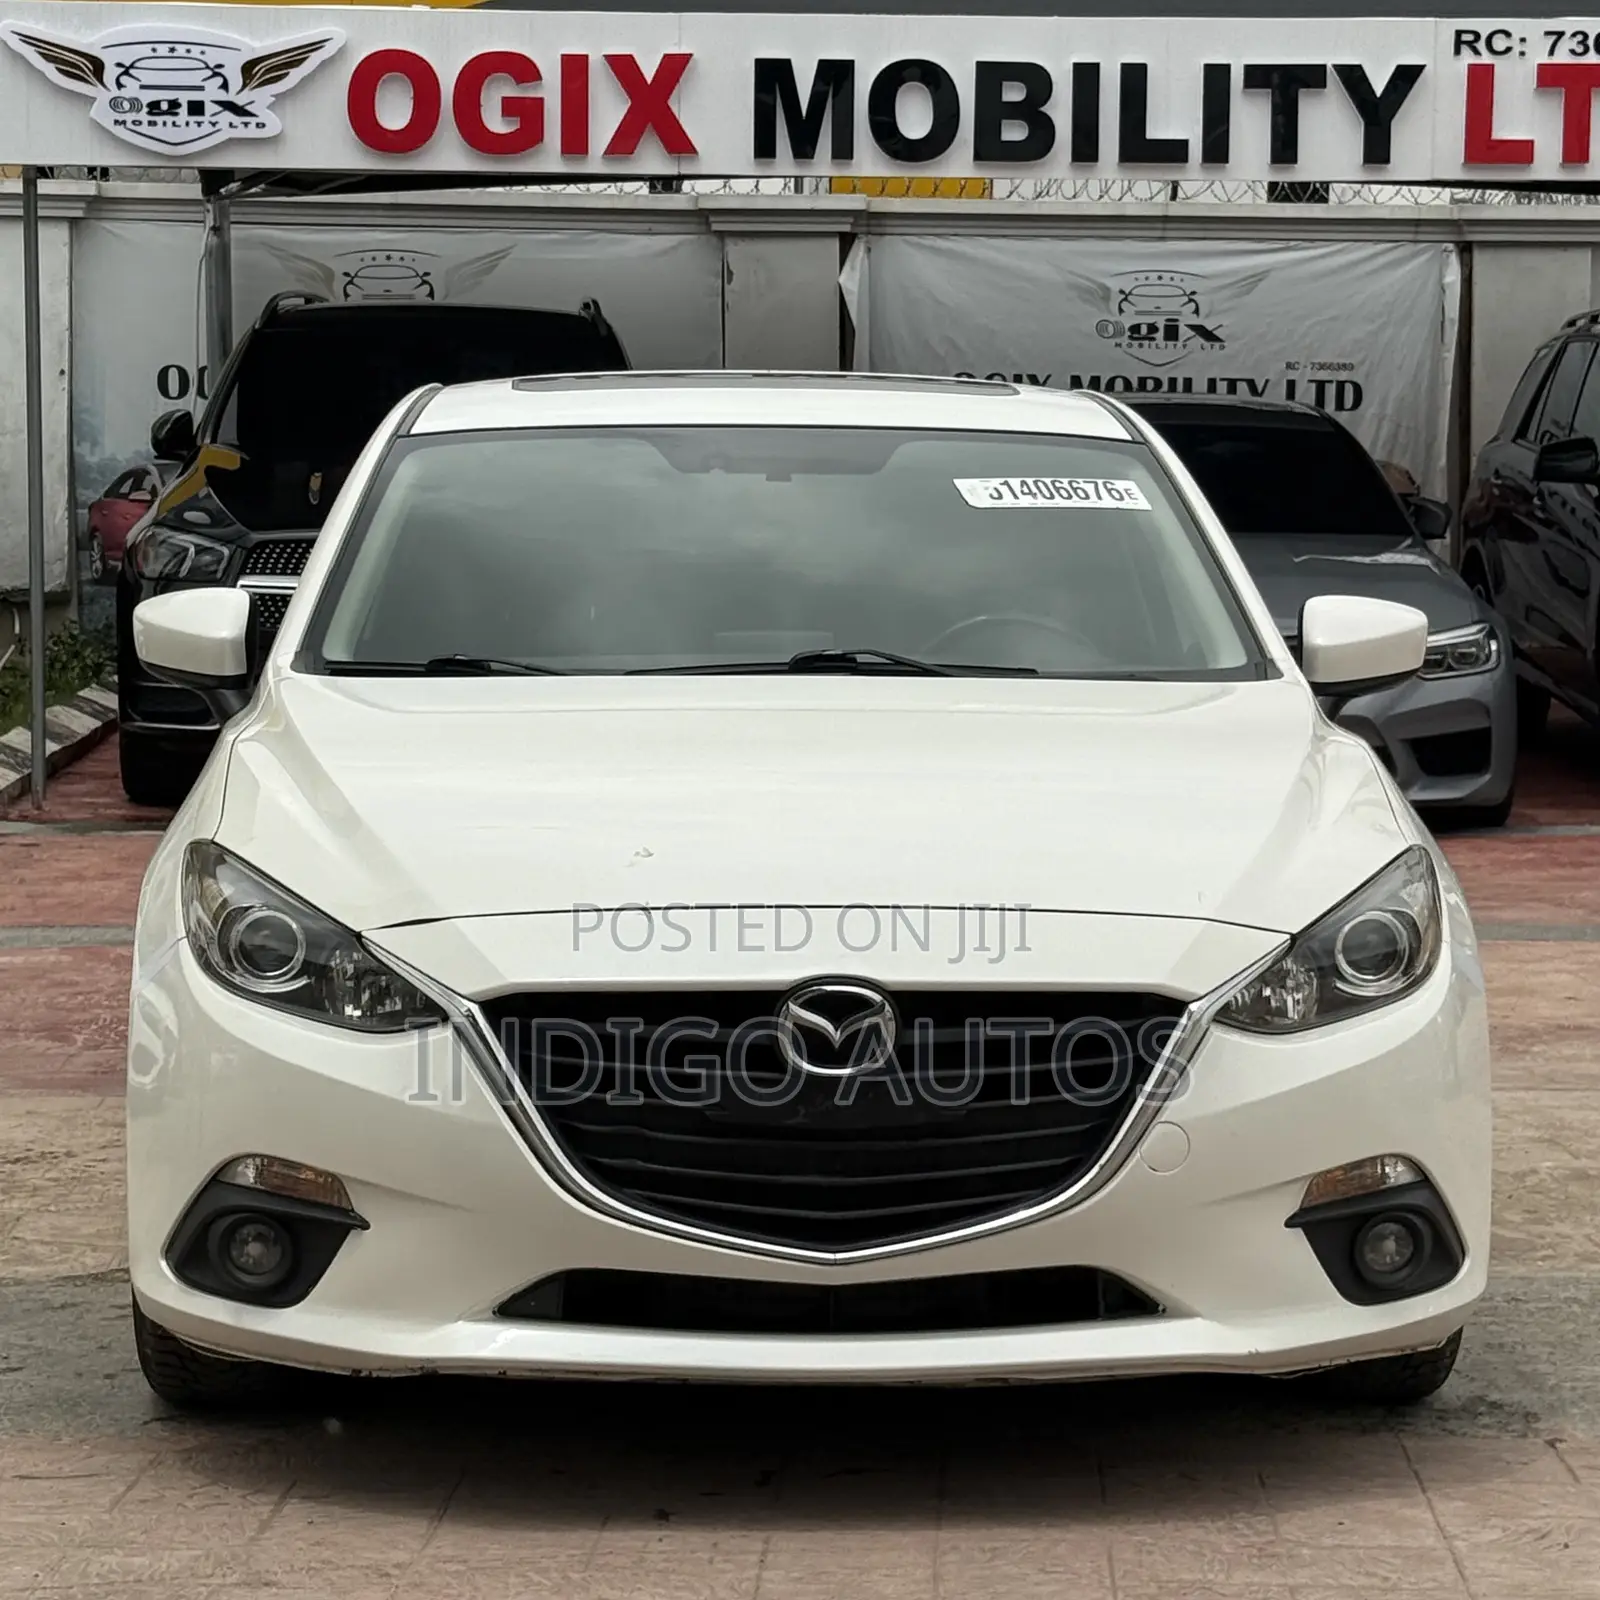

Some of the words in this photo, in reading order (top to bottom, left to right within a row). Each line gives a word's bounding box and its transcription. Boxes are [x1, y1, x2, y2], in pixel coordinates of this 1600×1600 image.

[1453, 29, 1527, 57] RC:
[347, 49, 698, 156] OGIX
[753, 58, 1427, 165] MOBILITY
[113, 119, 219, 128] MOBILITY
[1114, 341, 1188, 350] MOBILITY
[1200, 343, 1226, 351] LTD
[1285, 361, 1300, 371] RC
